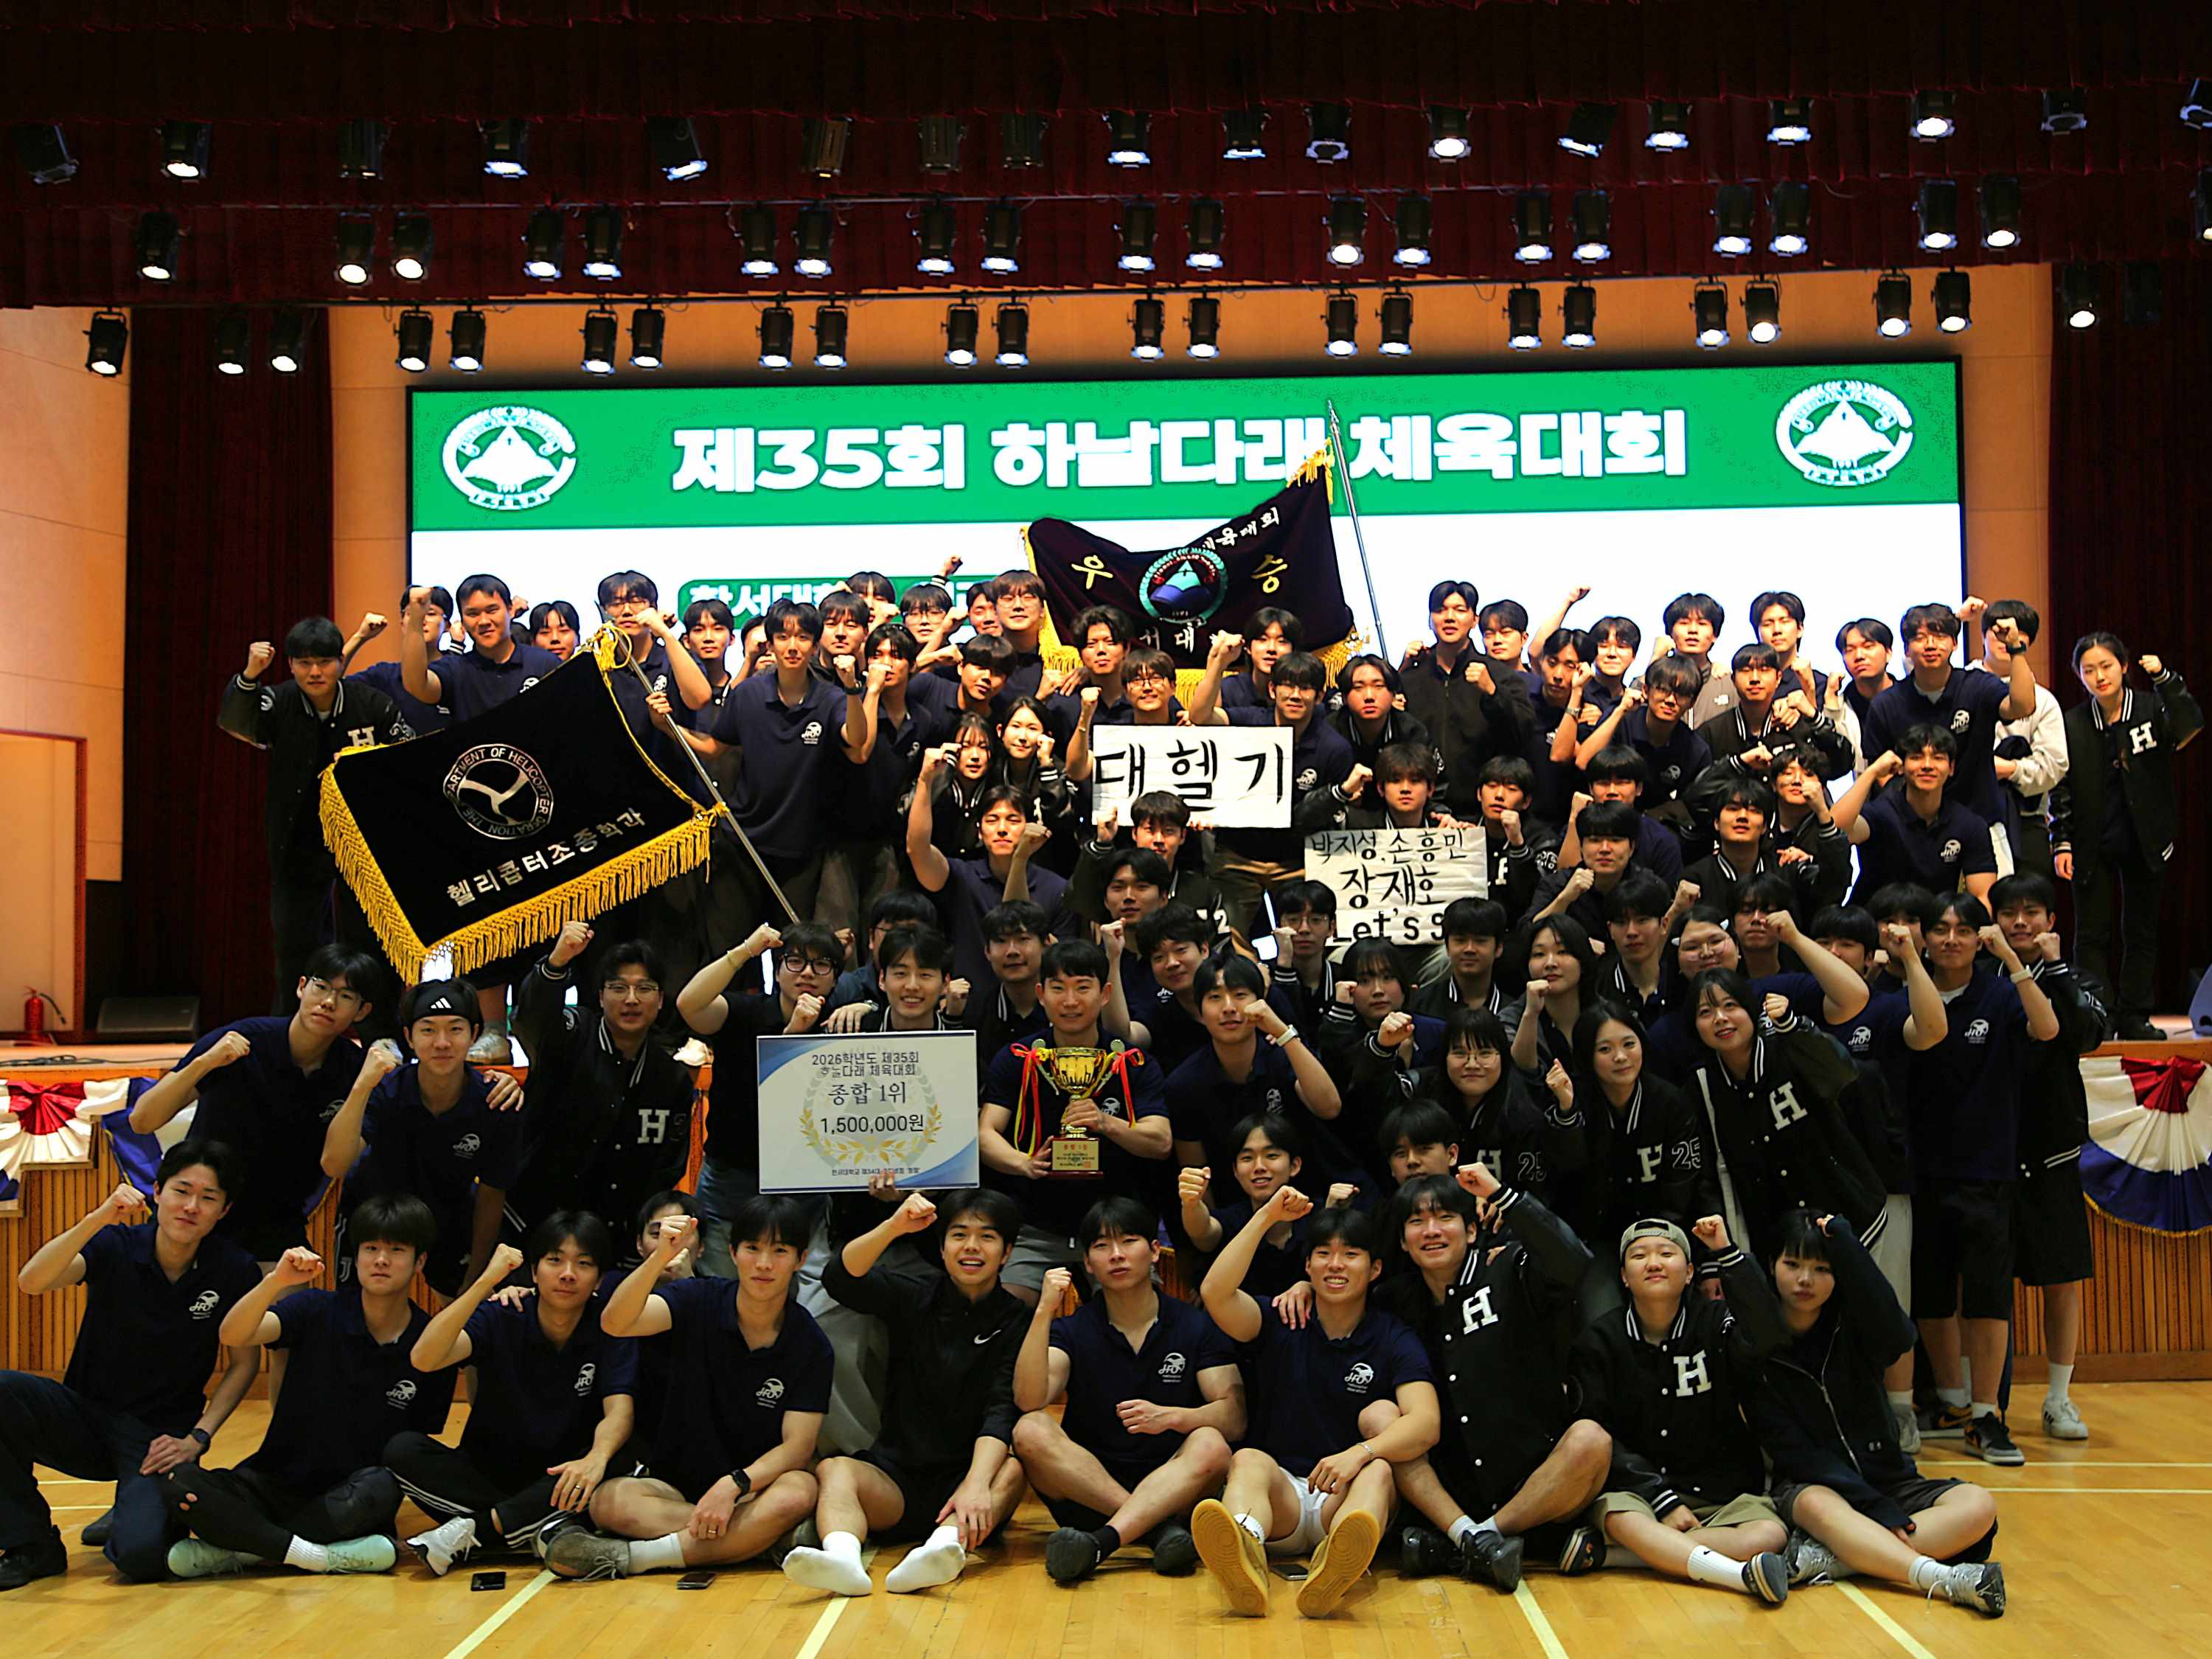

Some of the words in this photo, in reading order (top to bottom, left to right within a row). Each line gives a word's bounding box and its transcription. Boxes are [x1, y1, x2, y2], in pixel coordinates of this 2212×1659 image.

[672, 423, 965, 493] 제35회
[991, 413, 1327, 488] 하날다래
[1349, 408, 1687, 483] 체육대회
[1071, 554, 1113, 590] 우
[1251, 554, 1288, 594] 승
[490, 747, 507, 758] OF
[2129, 721, 2157, 755] H
[447, 748, 486, 796] PARTMENT
[508, 750, 550, 815] HELICOPTER
[1094, 739, 1283, 812] 대헬기
[488, 815, 546, 835] ERATION
[446, 807, 646, 907] 헬리콥터조종학과
[1340, 863, 1447, 908] 장재호
[813, 1051, 877, 1065] 2026학년도
[883, 1051, 919, 1063] 제35회
[870, 1063, 915, 1076] 체육대회
[828, 1082, 872, 1105] 종합
[879, 1082, 905, 1104] 1위
[1769, 1081, 1807, 1130] H
[637, 1109, 670, 1144] H
[821, 1114, 924, 1135] 1,500,000원
[1463, 1286, 1498, 1335] H
[1673, 1350, 1711, 1397] H
